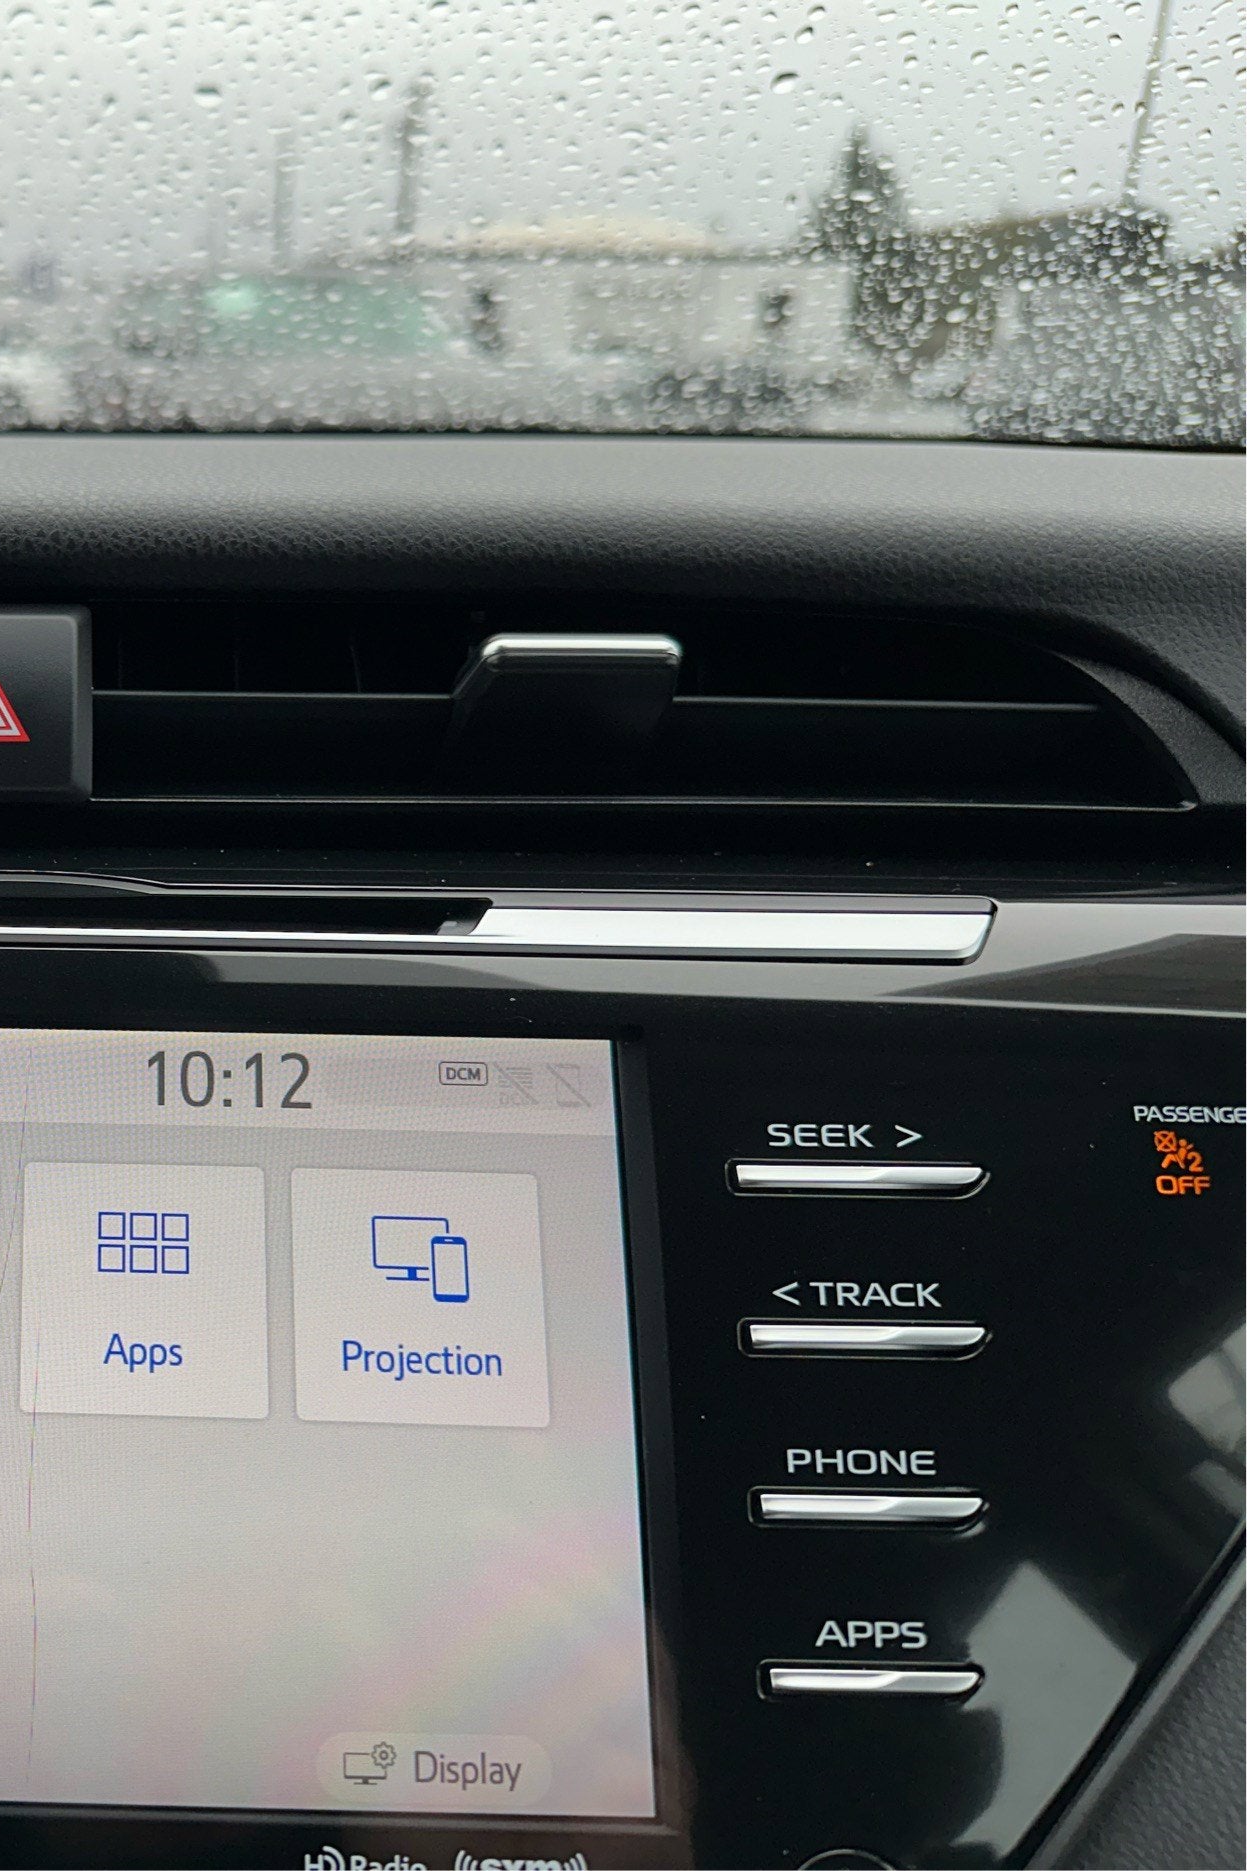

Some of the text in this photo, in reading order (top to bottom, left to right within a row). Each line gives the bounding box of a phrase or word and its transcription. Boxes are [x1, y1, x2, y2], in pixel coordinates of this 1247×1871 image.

[146, 1050, 313, 1110] 10:12
[445, 1066, 481, 1081] DCM
[766, 1123, 874, 1148] SEEK
[1155, 1175, 1211, 1195] OFF
[809, 1281, 942, 1308] TRACK
[103, 1332, 183, 1373] Apps
[341, 1338, 503, 1381] Projection
[786, 1448, 937, 1476] PHONE
[815, 1620, 927, 1649] APPS
[414, 1750, 522, 1792] Display
